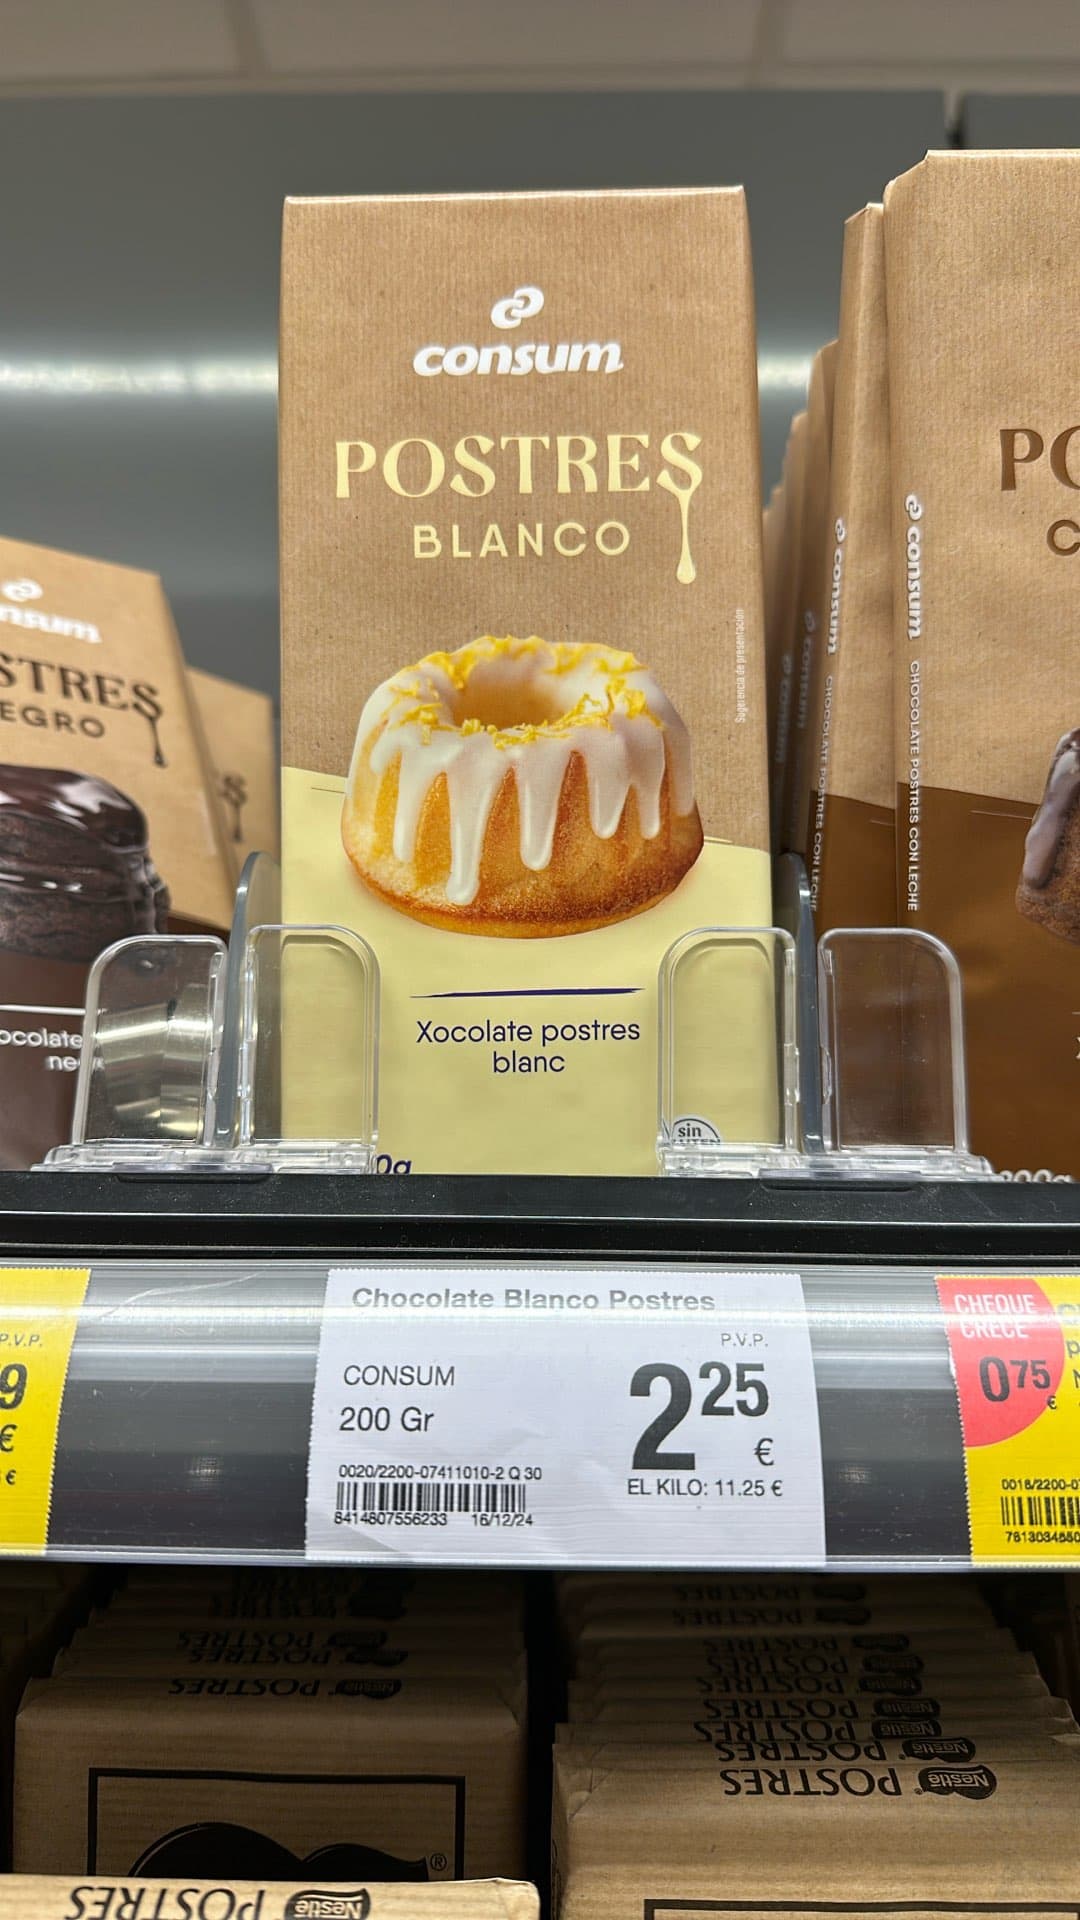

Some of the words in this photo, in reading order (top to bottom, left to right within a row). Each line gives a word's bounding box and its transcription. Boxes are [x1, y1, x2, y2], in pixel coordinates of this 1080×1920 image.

[413, 342, 624, 377] consum
[413, 521, 631, 559] BLANCO
[907, 526, 922, 640] consum
[827, 548, 843, 656] consum
[734, 676, 748, 724] Sugerencia
[909, 660, 921, 756] CHOCOLATE
[819, 674, 834, 764] CHOCOLATE
[908, 758, 920, 824] POSTRES
[812, 831, 823, 865] CON
[908, 827, 920, 861] CON
[907, 865, 919, 911] LECHE
[416, 1020, 533, 1044] Xocolate
[541, 1020, 640, 1046] postres
[492, 1051, 566, 1074] blanc
[678, 1122, 702, 1137] sin
[351, 1286, 495, 1309] Chocolate
[504, 1288, 600, 1310] Blanco
[609, 1289, 716, 1311] Postres
[954, 1293, 1037, 1315] CHEQUE
[721, 1333, 768, 1347] P.V.P.
[344, 1365, 455, 1386] CONSUM
[978, 1356, 1010, 1402] 0
[1009, 1359, 1051, 1389] 75
[339, 1406, 391, 1431] 200
[401, 1406, 435, 1432] Gr
[630, 1362, 696, 1470] 2
[699, 1361, 769, 1417] 25
[754, 1437, 775, 1466] €
[339, 1464, 505, 1480] 0020/2200-07411010-2
[508, 1466, 521, 1480] Q
[524, 1466, 543, 1480] 30
[627, 1478, 652, 1495] EL
[656, 1478, 709, 1496] KILO:
[715, 1479, 766, 1497] 11.25
[770, 1479, 783, 1497] €
[334, 1511, 448, 1527] 8414807556233
[471, 1513, 534, 1527] 16/12/24
[168, 1678, 321, 1696] POSTRES
[703, 1698, 859, 1720] POSTRES
[694, 1720, 856, 1741] POSTRES
[715, 1740, 887, 1761] POSTRES
[720, 1767, 903, 1797] POSTRES
[64, 1886, 266, 1920] POSTRES
